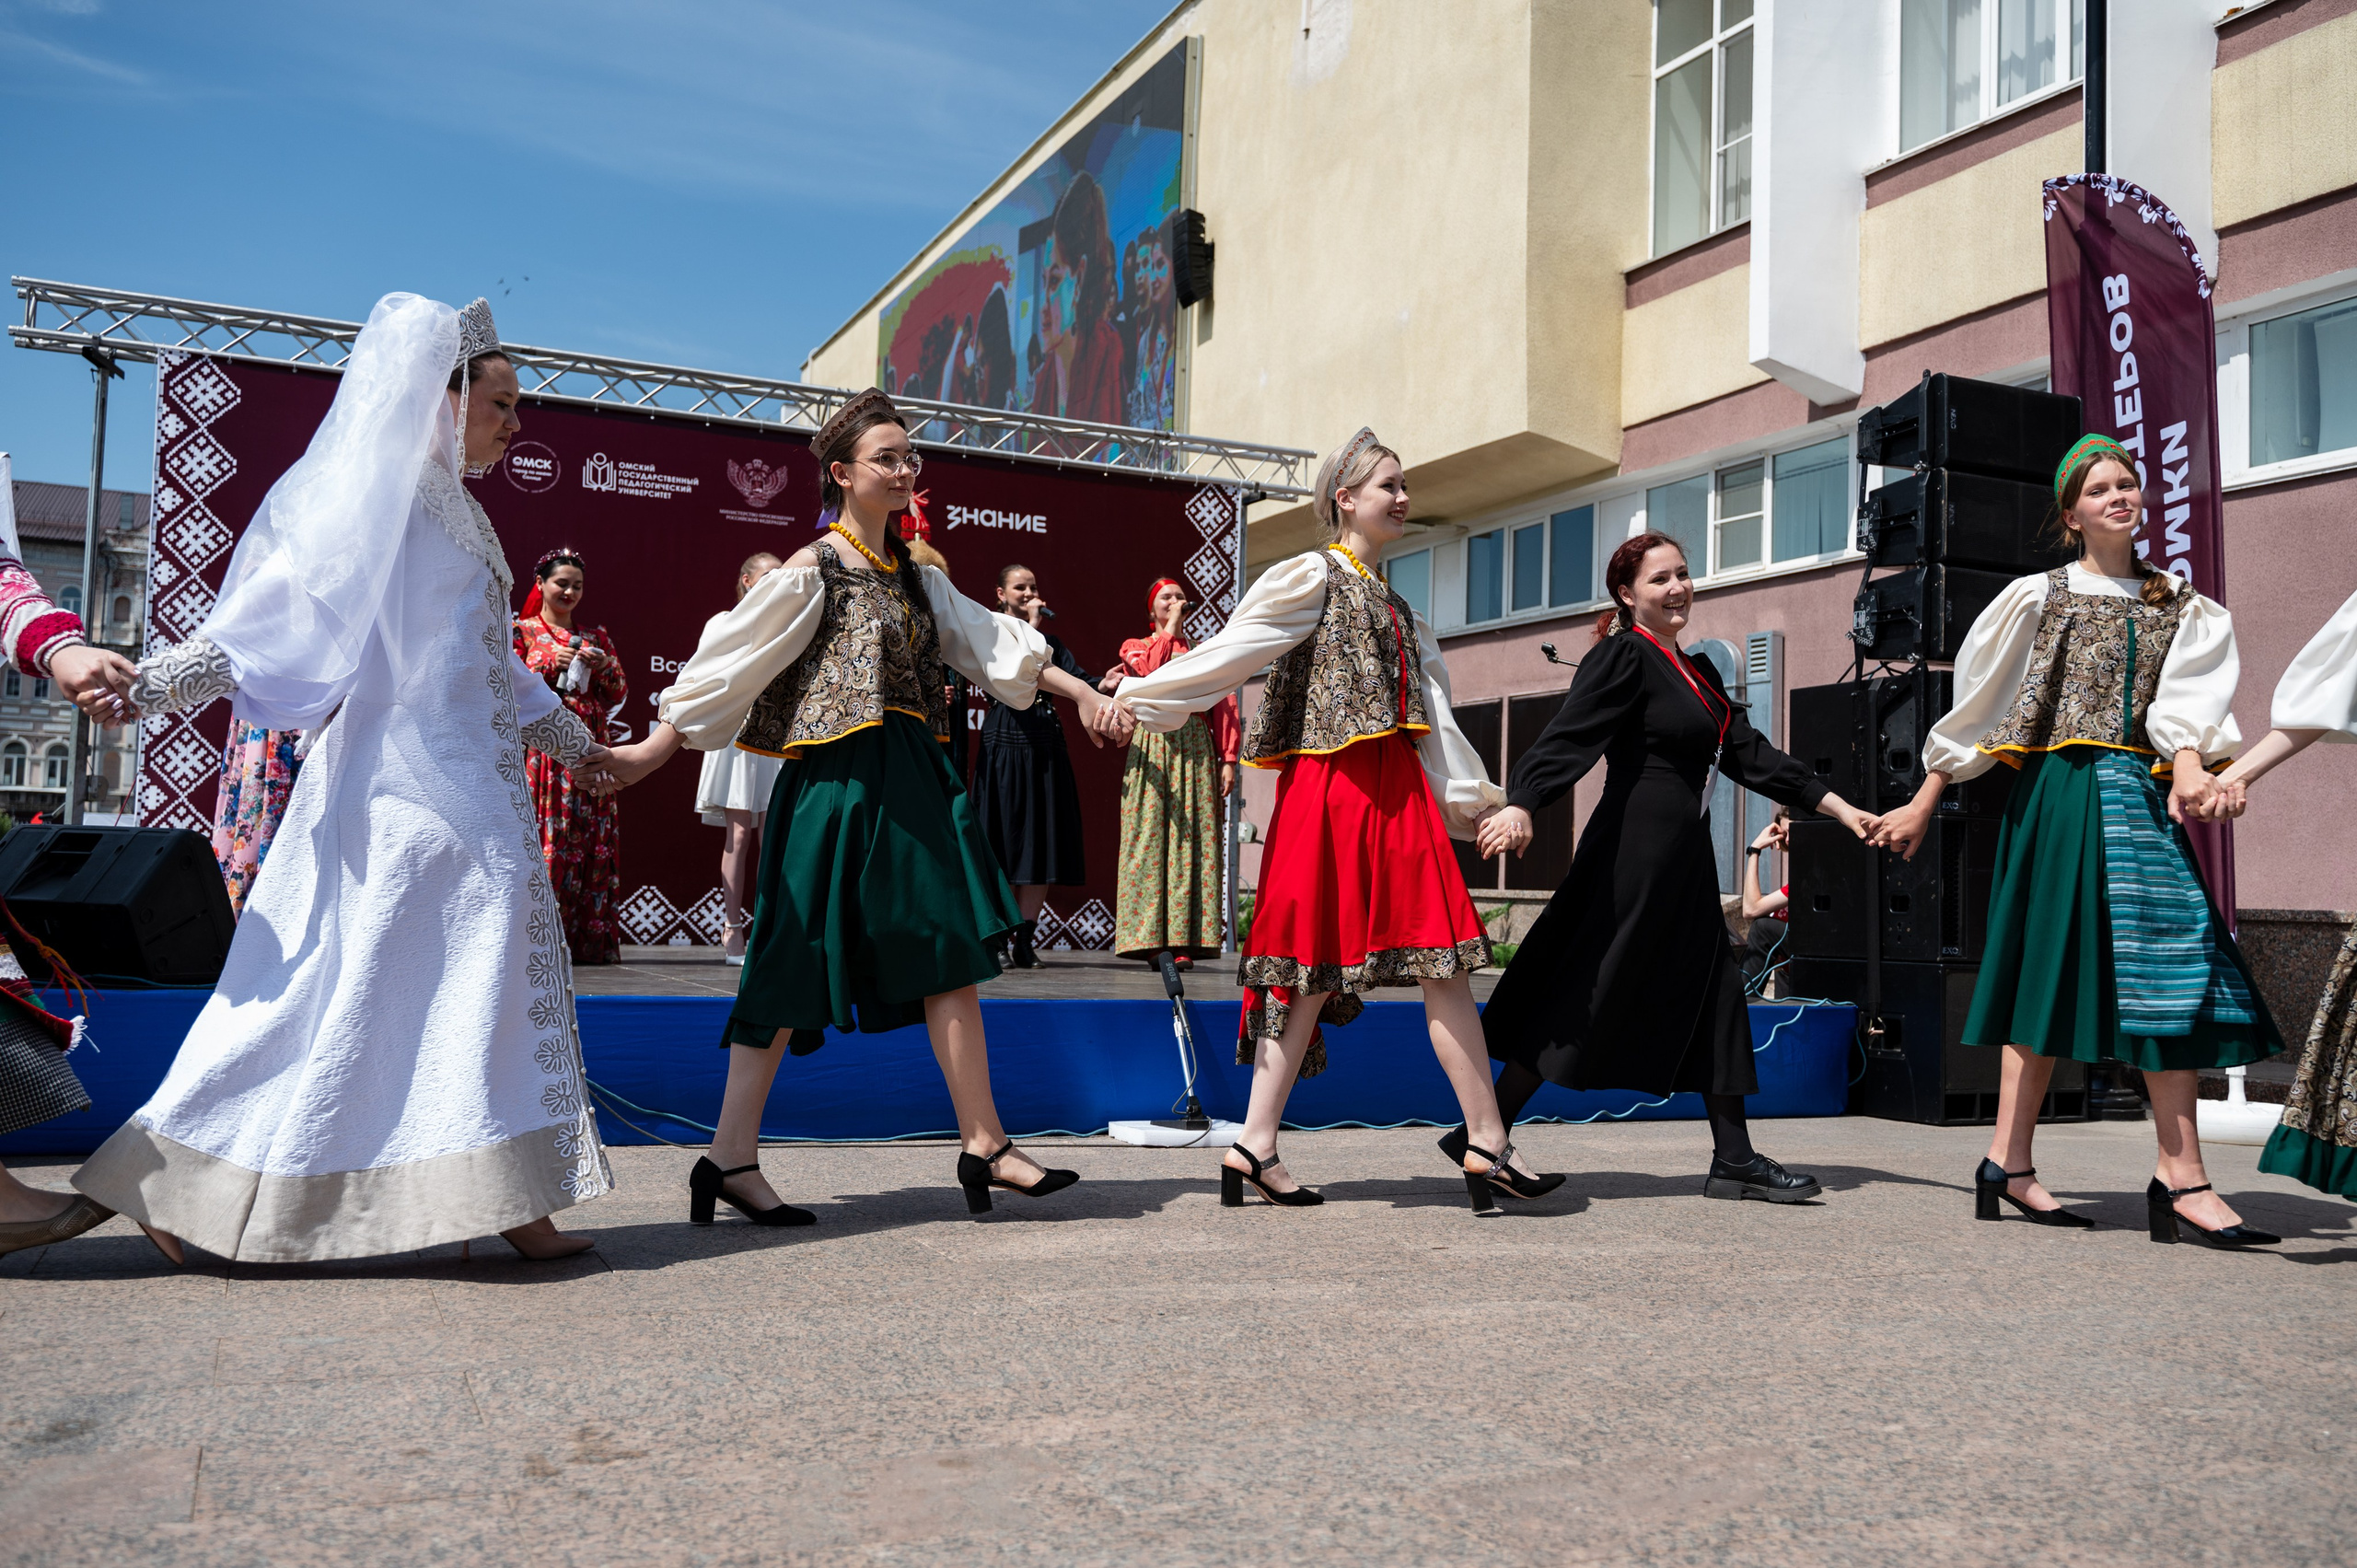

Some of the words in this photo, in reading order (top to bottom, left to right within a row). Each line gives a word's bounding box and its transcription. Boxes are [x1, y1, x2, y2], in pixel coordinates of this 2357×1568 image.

[512, 456, 552, 470] ОМСК
[618, 461, 656, 472] ОМСКИЙ
[618, 470, 700, 486] ГОСУДАРСТВЕННЫЙ
[618, 478, 692, 494] ПЕДАГОГИЧЕСКИЙ
[618, 486, 672, 500] УНИВЕРСИТЕТ
